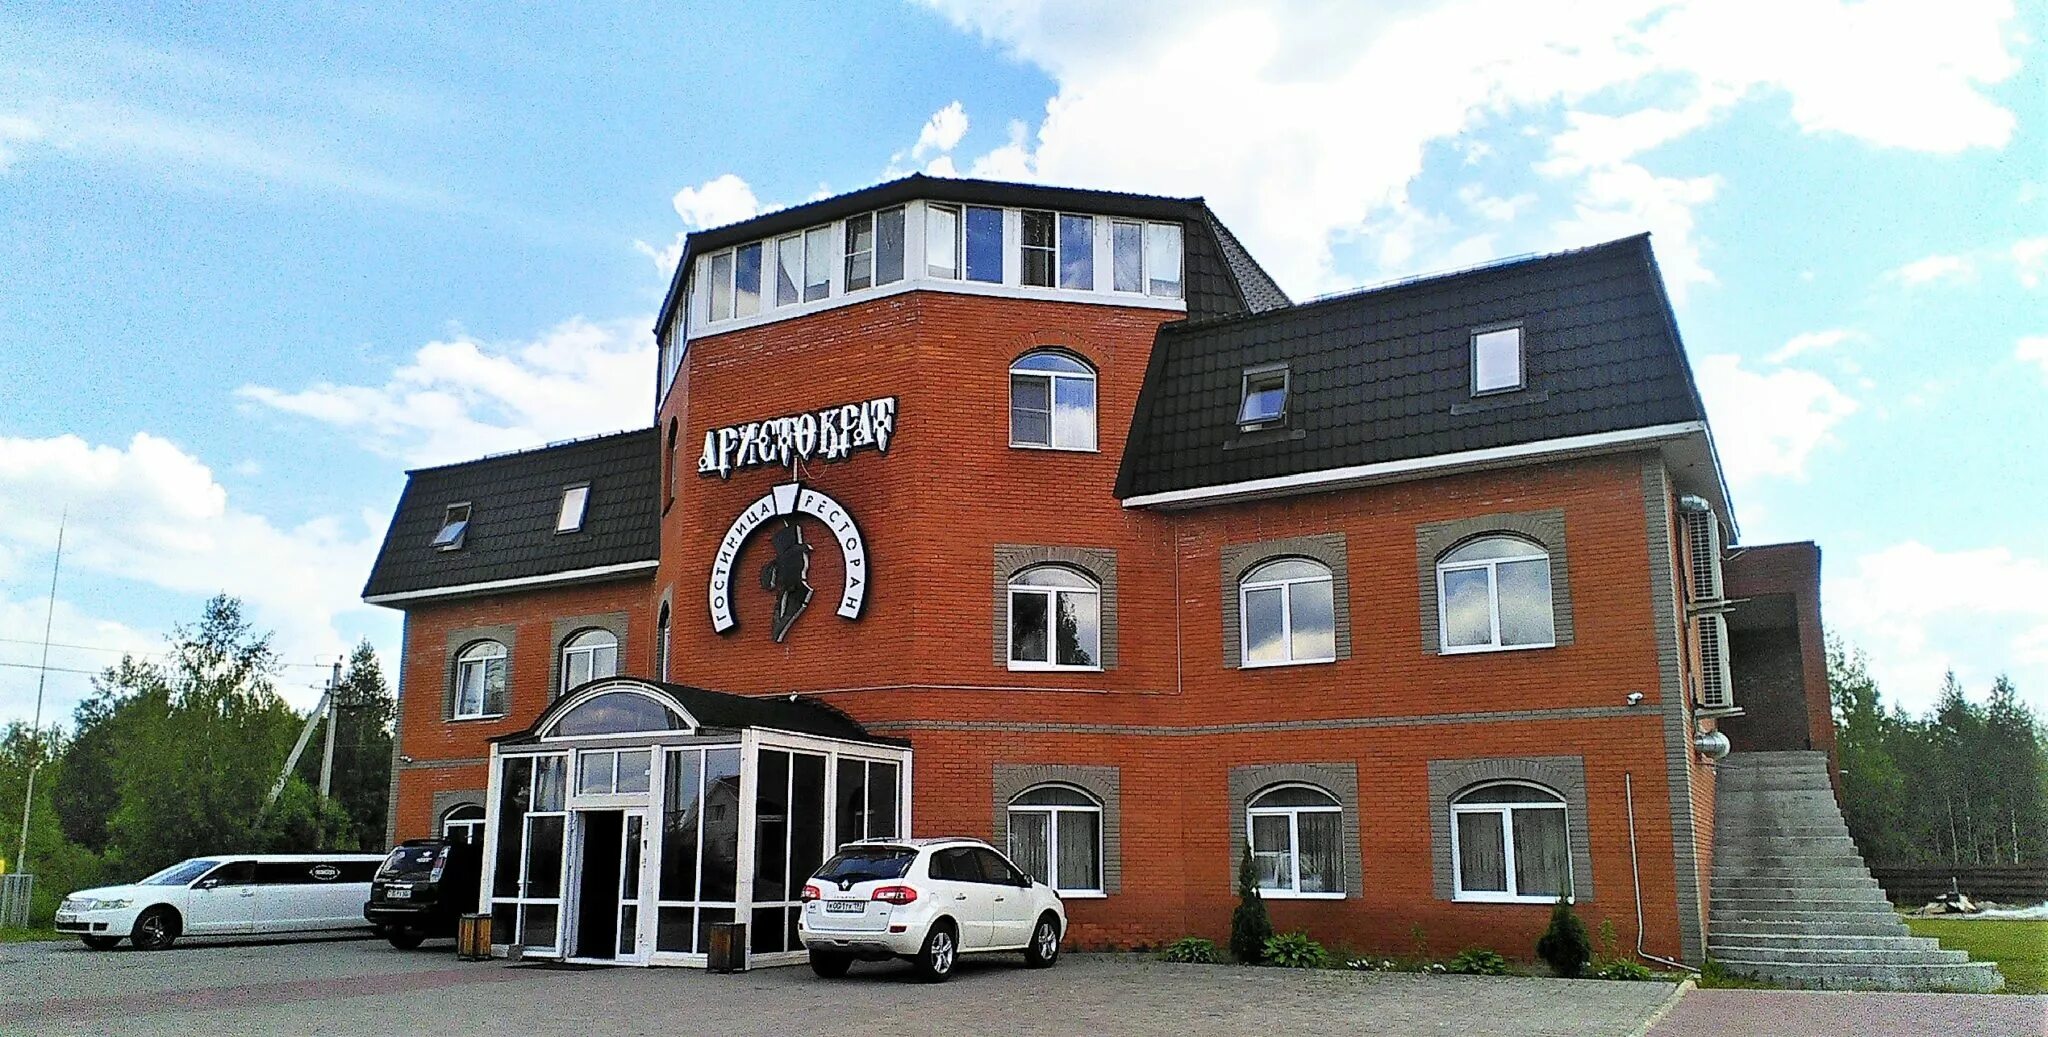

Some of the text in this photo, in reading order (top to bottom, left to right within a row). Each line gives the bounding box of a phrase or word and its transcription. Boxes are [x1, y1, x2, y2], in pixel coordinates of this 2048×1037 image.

[697, 397, 896, 479] АРИСТОКРАТ
[714, 502, 770, 621] ГОСТИНИЦА
[805, 495, 861, 609] РЕСТОРАН
